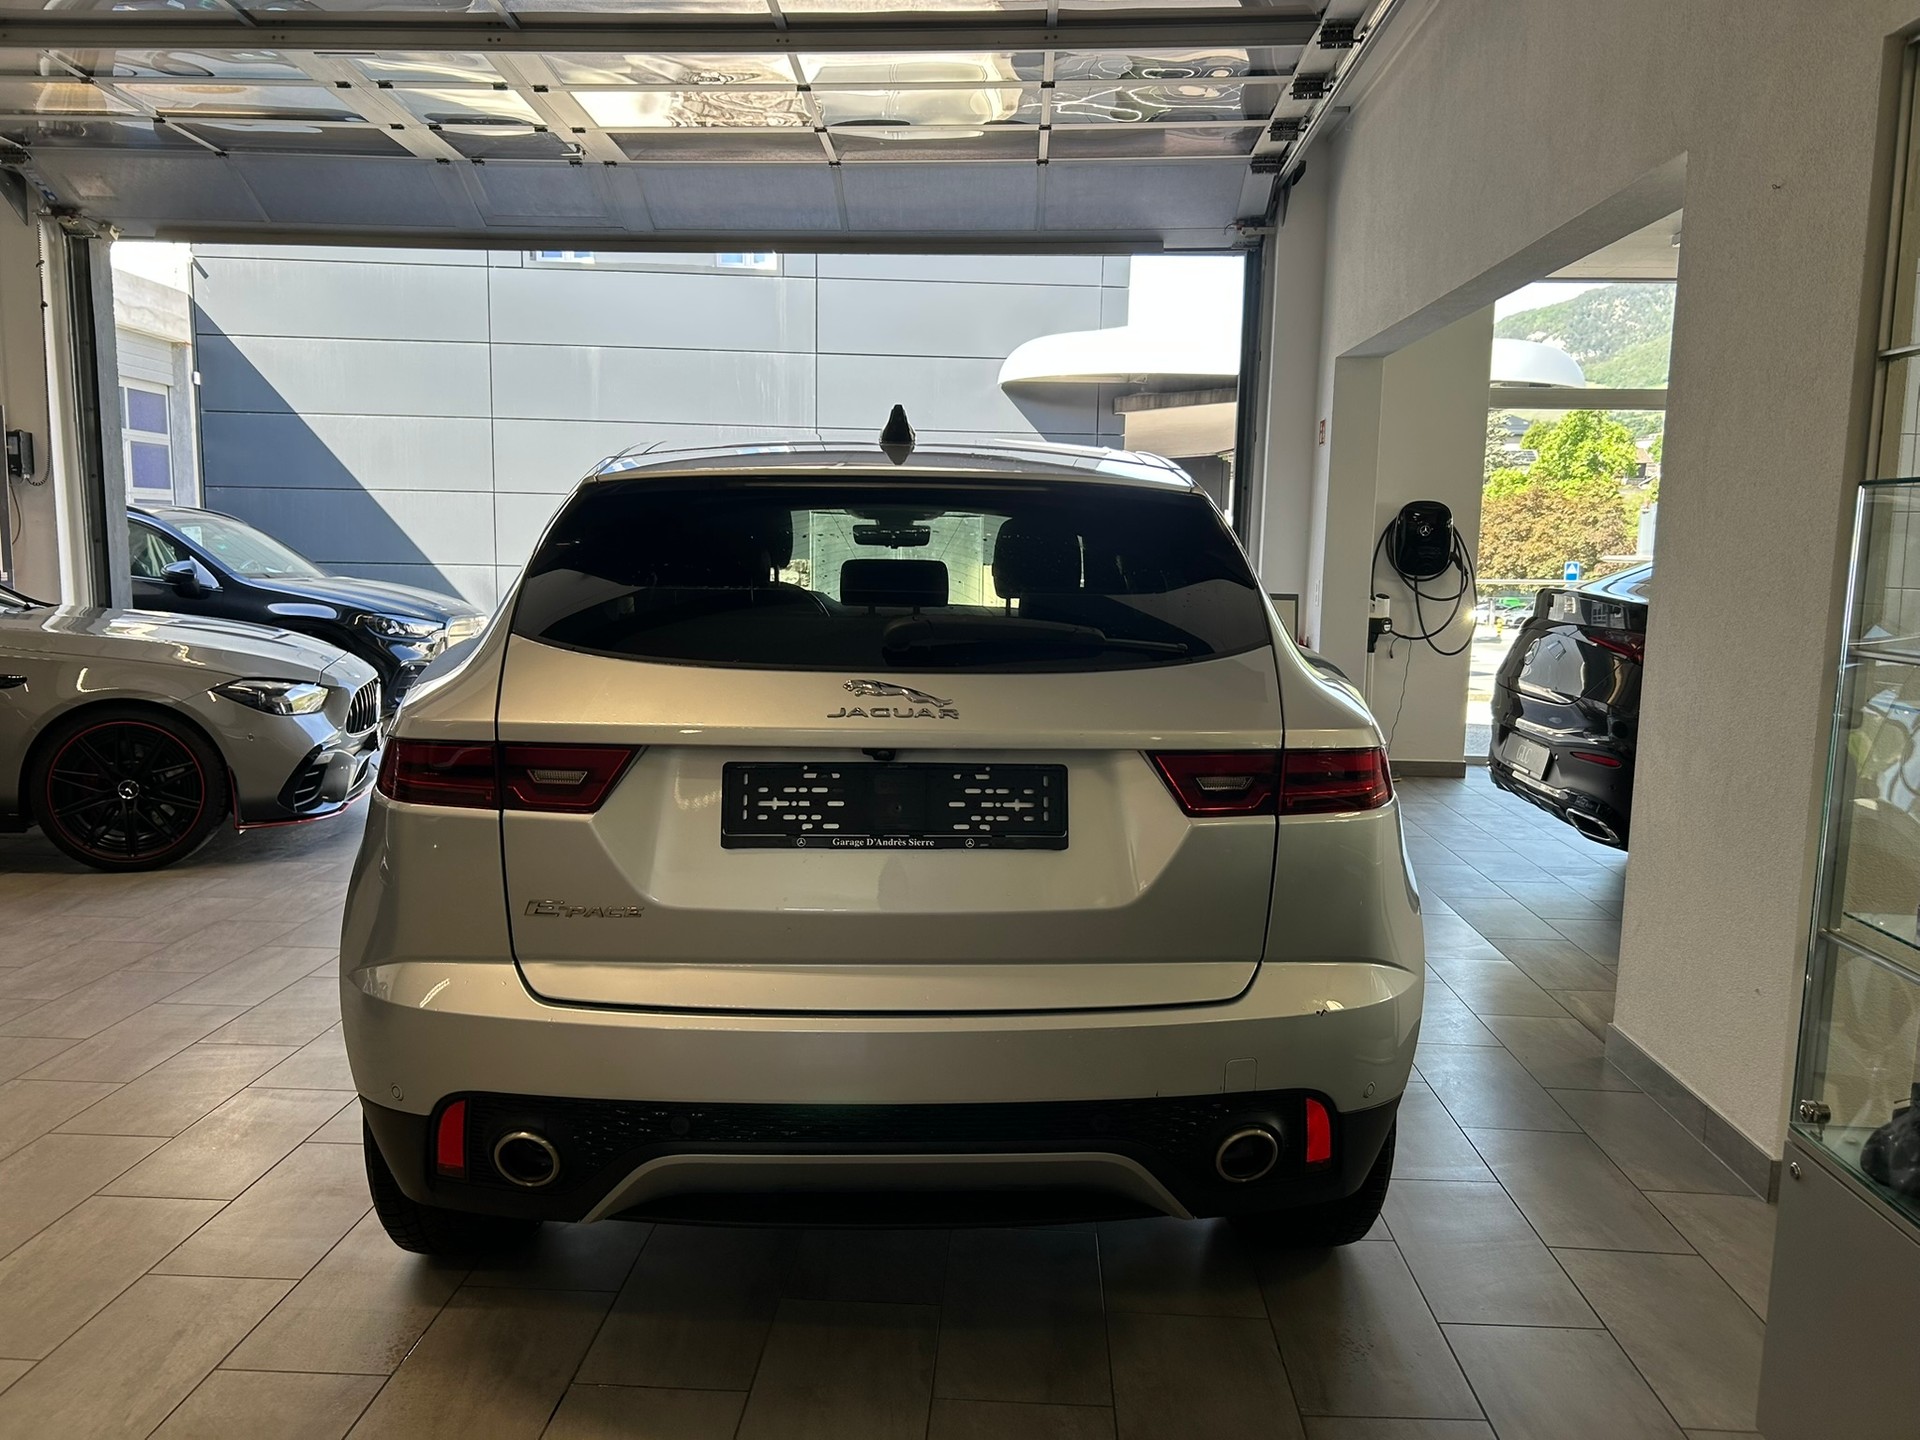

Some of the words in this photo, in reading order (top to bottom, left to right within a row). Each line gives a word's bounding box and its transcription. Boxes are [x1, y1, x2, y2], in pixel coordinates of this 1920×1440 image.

[827, 707, 960, 720] JAGUAR
[1516, 744, 1532, 764] GLC
[832, 838, 864, 847] Garage
[866, 838, 907, 847] D'Andrès
[908, 838, 935, 847] Sierre
